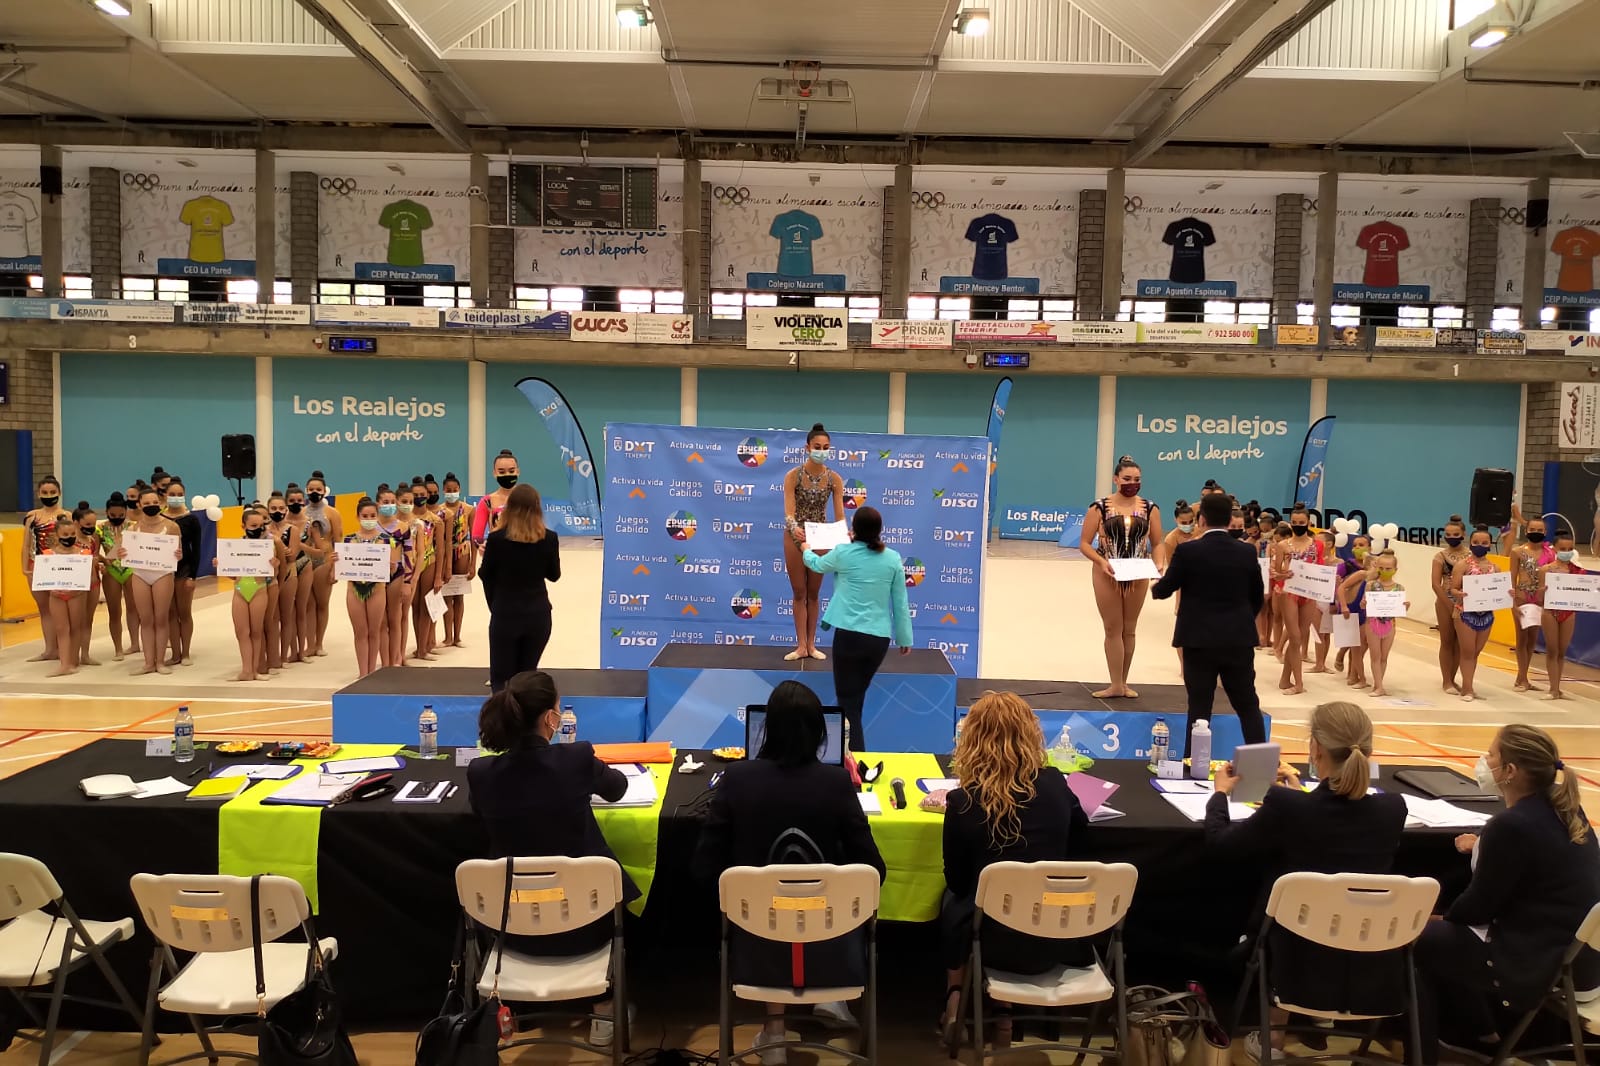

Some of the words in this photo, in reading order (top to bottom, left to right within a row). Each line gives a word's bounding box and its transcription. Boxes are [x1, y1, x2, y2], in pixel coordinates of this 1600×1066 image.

[560, 244, 580, 256] con
[584, 239, 595, 256] el
[598, 240, 649, 260] deporte
[184, 266, 199, 274] CEO
[200, 266, 209, 275] La
[371, 270, 388, 279] CEIP
[410, 271, 439, 281] Zamora
[768, 279, 795, 290] Colegio
[796, 280, 824, 289] Nazaret
[954, 284, 970, 292] CEIP
[972, 284, 1000, 294] Mencey
[1145, 286, 1162, 295] CEIP
[1194, 288, 1227, 298] Espinosa
[1338, 290, 1364, 302] Colegio
[1366, 291, 1390, 300] Pureza
[1392, 291, 1401, 300] de
[1544, 295, 1560, 304] CEIP
[464, 310, 521, 325] teideplast
[774, 316, 843, 329] VIOLENCIA
[792, 328, 826, 339] CERO
[902, 326, 946, 336] PRISMA
[1214, 330, 1228, 338] 922
[129, 335, 137, 348] 3
[788, 352, 797, 365] 2
[1453, 364, 1459, 377] 1
[293, 395, 334, 415] Los
[342, 396, 446, 422] Realejos
[1136, 414, 1177, 433] Los
[1184, 414, 1288, 440] Realejos
[316, 431, 341, 443] con
[344, 422, 358, 442] el
[362, 424, 424, 448] deporte
[624, 441, 656, 452] DXT
[670, 441, 694, 450] Activa
[695, 442, 704, 450] tu
[705, 442, 722, 451] vida
[838, 450, 869, 461] DXT
[936, 451, 959, 460] Activa
[961, 452, 969, 460] tu
[970, 452, 986, 461] vida
[1158, 449, 1182, 461] con
[1186, 440, 1200, 461] el
[1204, 442, 1264, 466] deporte
[612, 476, 636, 485] Activa
[637, 478, 646, 486] tu
[647, 478, 664, 486] vida
[670, 480, 703, 489] Juegos
[670, 488, 702, 498] Cabildo
[724, 484, 756, 495] DXT
[882, 488, 916, 497] Juegos
[882, 498, 915, 506] Cabildo
[546, 503, 573, 513] Juego
[616, 515, 649, 525] Juegos
[1006, 509, 1027, 521] Los
[616, 525, 649, 534] Cabildo
[724, 522, 753, 533] DXT
[882, 526, 914, 535] Juegos
[881, 536, 913, 544] Cabildo
[945, 530, 975, 542] DXT
[616, 554, 641, 562] Activa
[642, 554, 650, 562] tu
[652, 555, 668, 563] vida
[730, 558, 763, 567] Juegos
[730, 566, 762, 577] Cabildo
[941, 564, 973, 575] Juegos
[941, 574, 973, 584] Cabildo
[620, 594, 650, 605] DXT
[665, 594, 689, 602] Activa
[690, 594, 699, 602] tu
[700, 595, 716, 603] vida
[924, 603, 948, 611] Activa
[959, 604, 975, 613] vida
[670, 630, 704, 640] Juegos
[726, 634, 755, 645] DXT
[770, 634, 793, 643] Activa
[1102, 723, 1120, 752] 3
